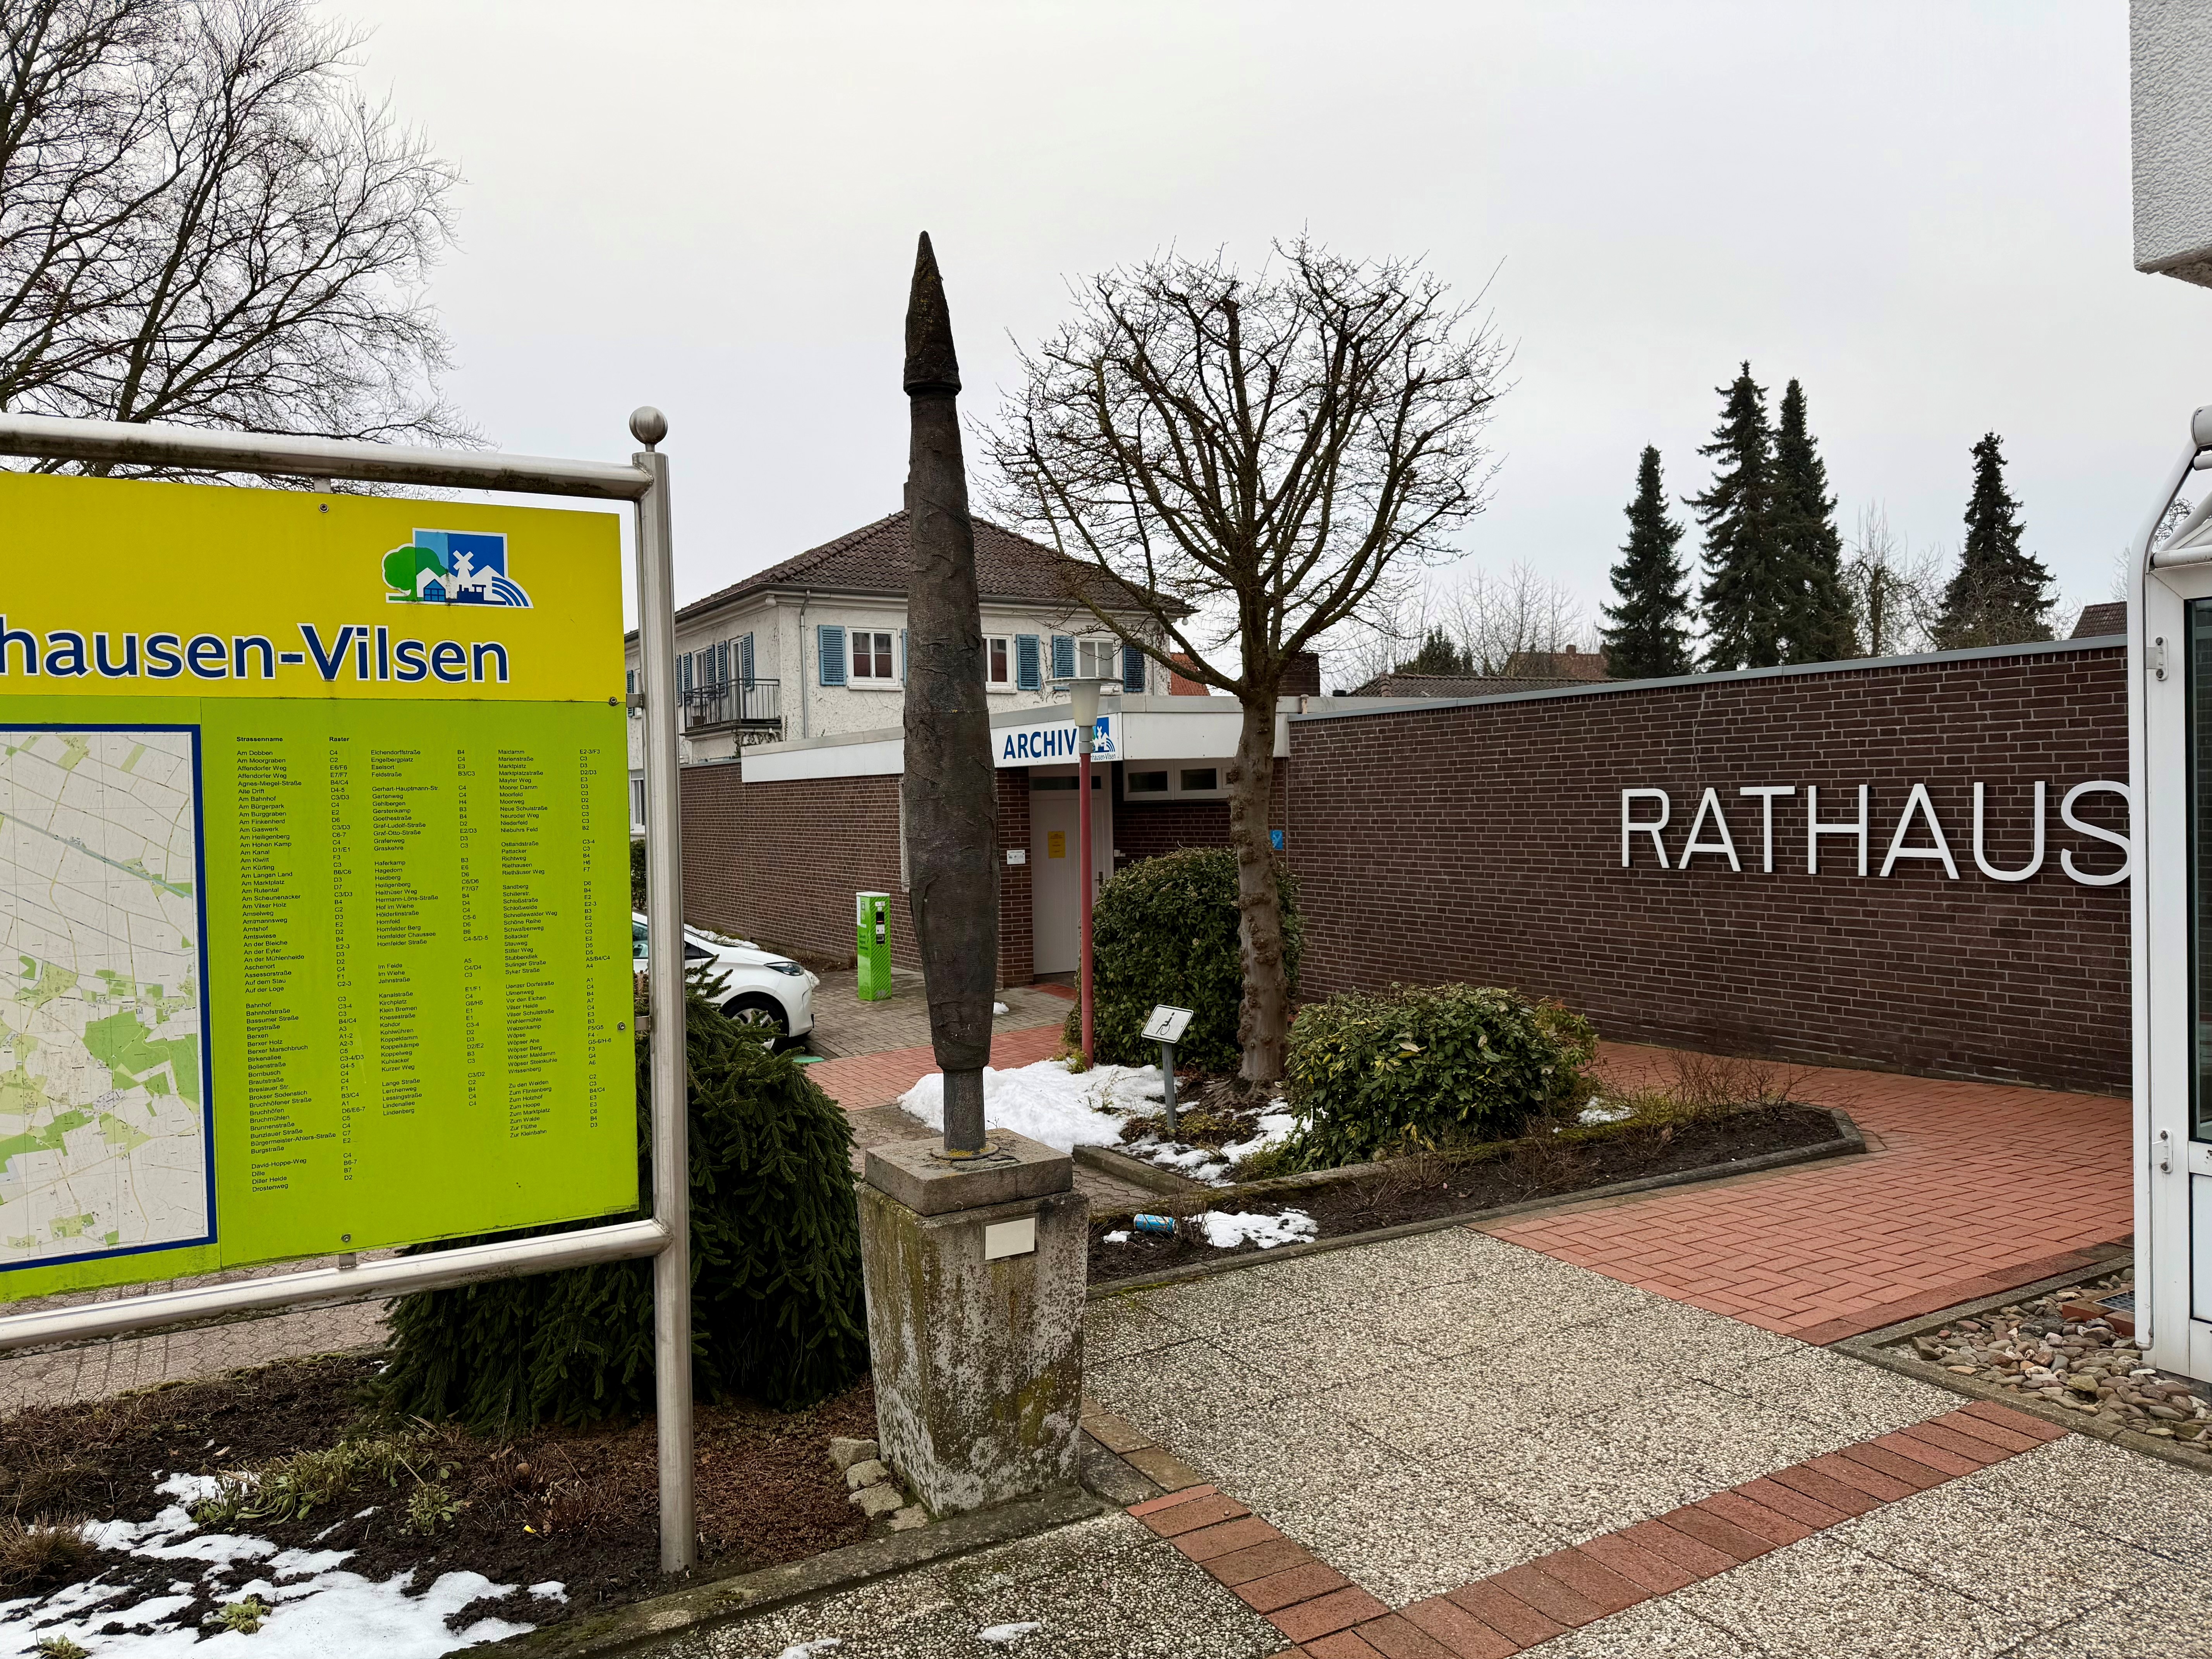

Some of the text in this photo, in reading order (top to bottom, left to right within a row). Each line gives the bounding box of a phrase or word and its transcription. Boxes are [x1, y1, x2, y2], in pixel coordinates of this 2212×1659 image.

[0, 614, 509, 683] hausen-Vilsen
[1003, 728, 1077, 759] ARCHIV
[1622, 780, 2130, 886] RATHAUS
[246, 1008, 290, 1016] Bahnhofstraße
[250, 1115, 290, 1123] Bruchmühlen
[250, 1121, 295, 1131] Brunnenstraße
[251, 1158, 307, 1169] David-Hoppe-Weg
[252, 1183, 289, 1192] Drostenweg
